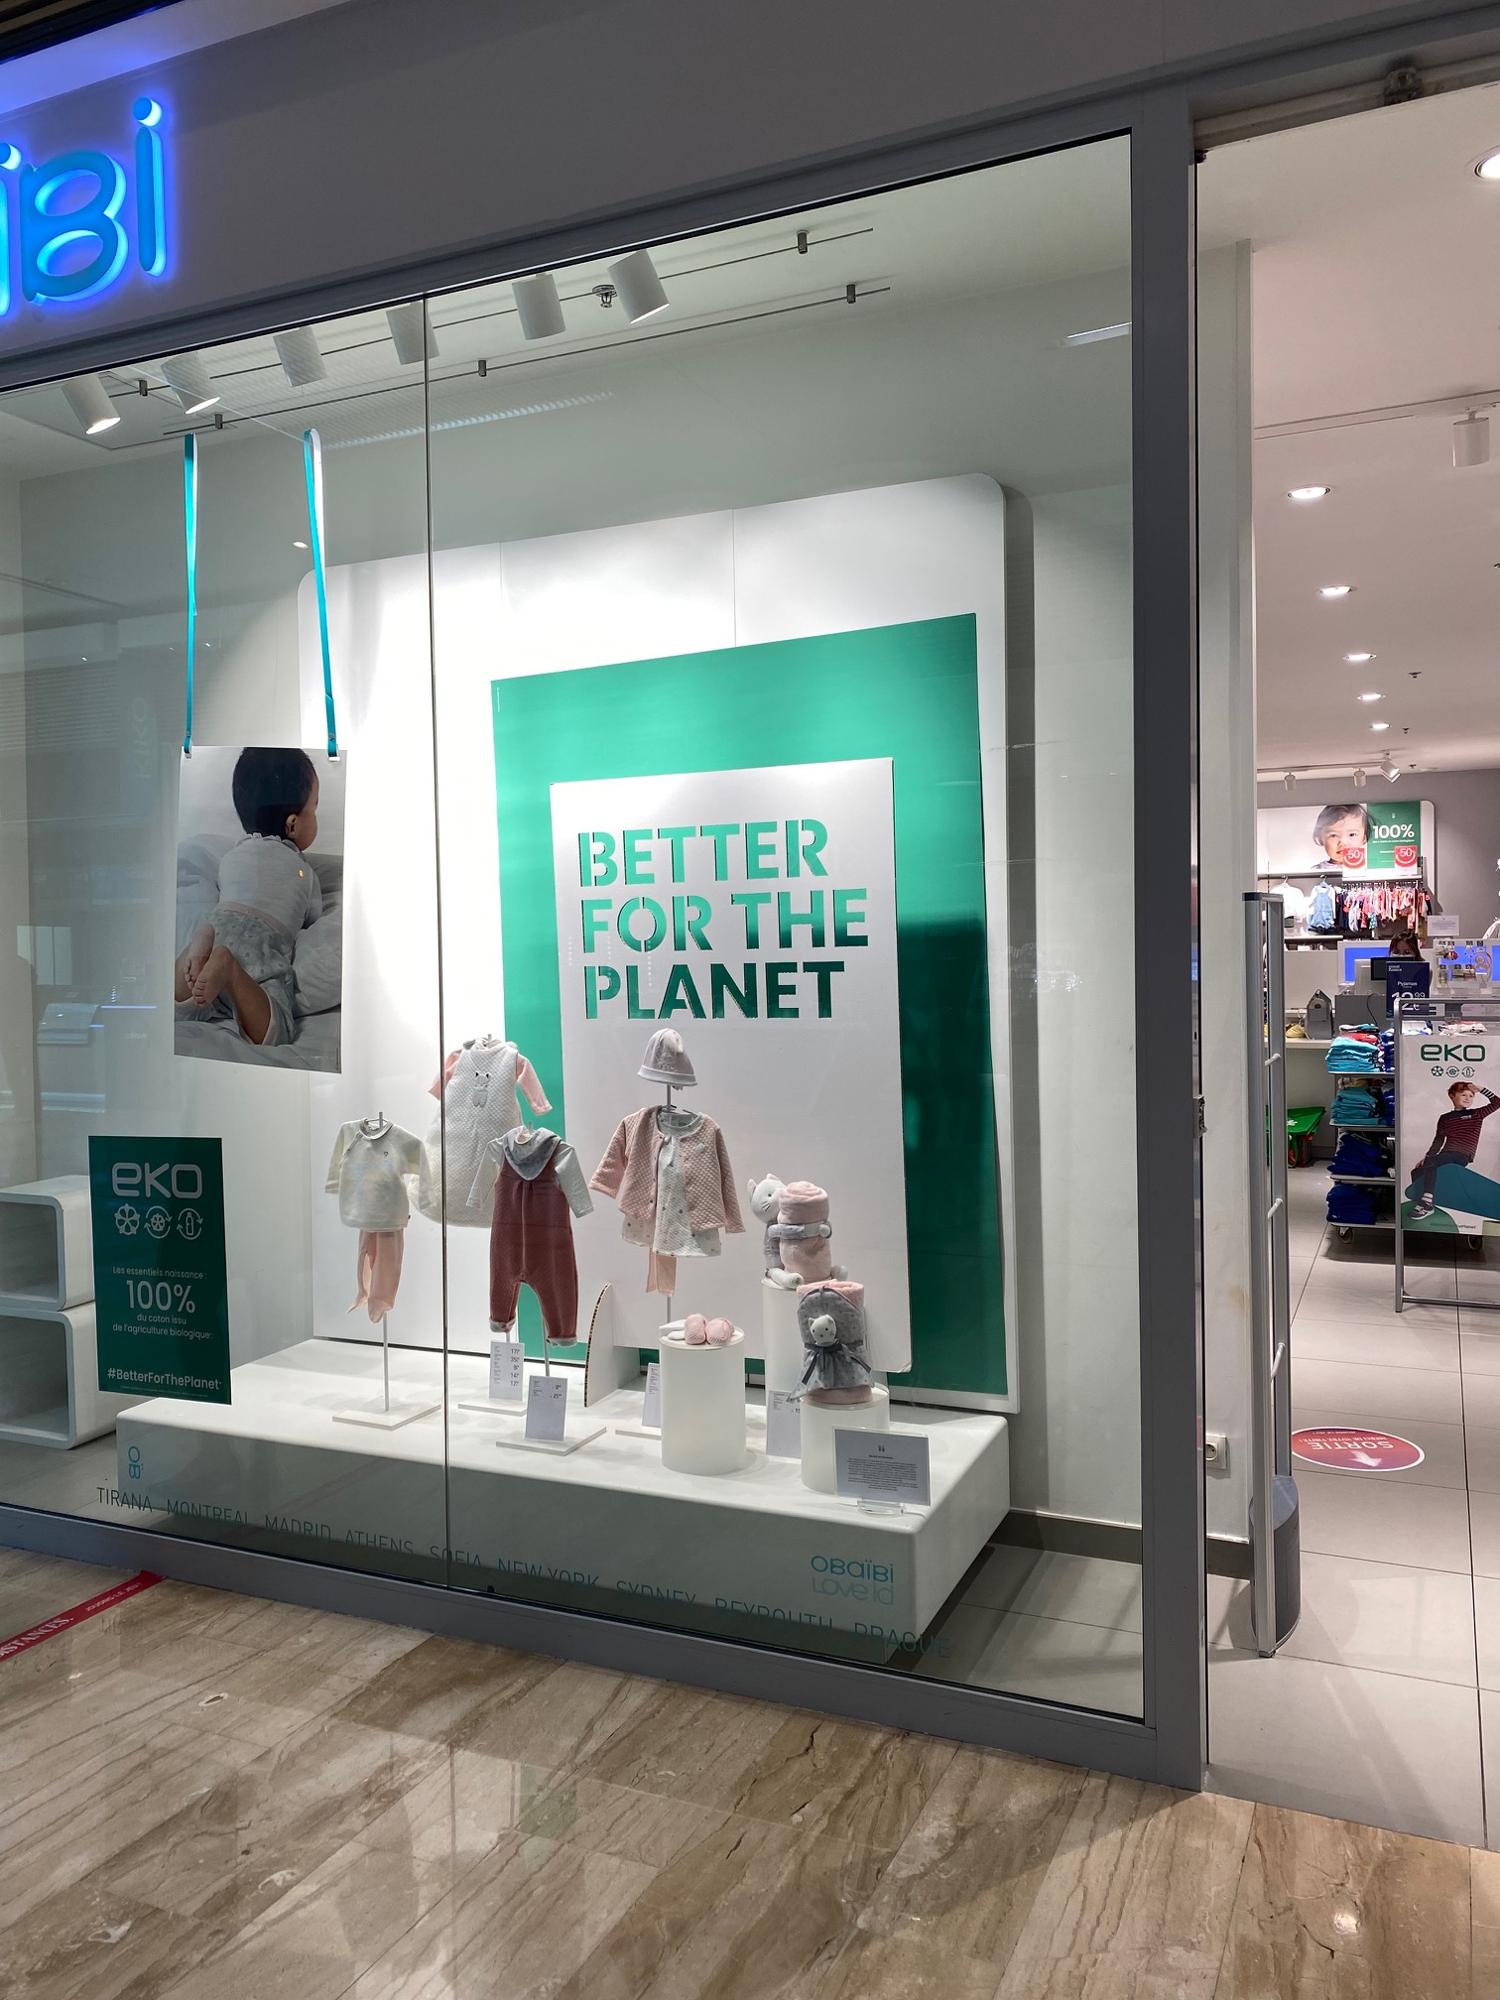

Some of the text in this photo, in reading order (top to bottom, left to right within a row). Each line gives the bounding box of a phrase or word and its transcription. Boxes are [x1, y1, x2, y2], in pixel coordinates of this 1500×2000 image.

[1372, 824, 1415, 840] 100%
[577, 818, 829, 888] BETTER
[580, 887, 869, 954] FOR THE
[583, 960, 846, 1020] PLANET
[112, 1266, 125, 1275] Les
[126, 1267, 163, 1277] essentiels
[126, 1279, 196, 1314] 100%
[112, 1323, 123, 1332] de
[137, 1313, 187, 1324] du coton issu
[1308, 1440, 1394, 1451] SORTIE
[96, 1486, 153, 1513] TIRANA
[265, 1514, 332, 1541] MADRID
[345, 1528, 415, 1556] ATHENS
